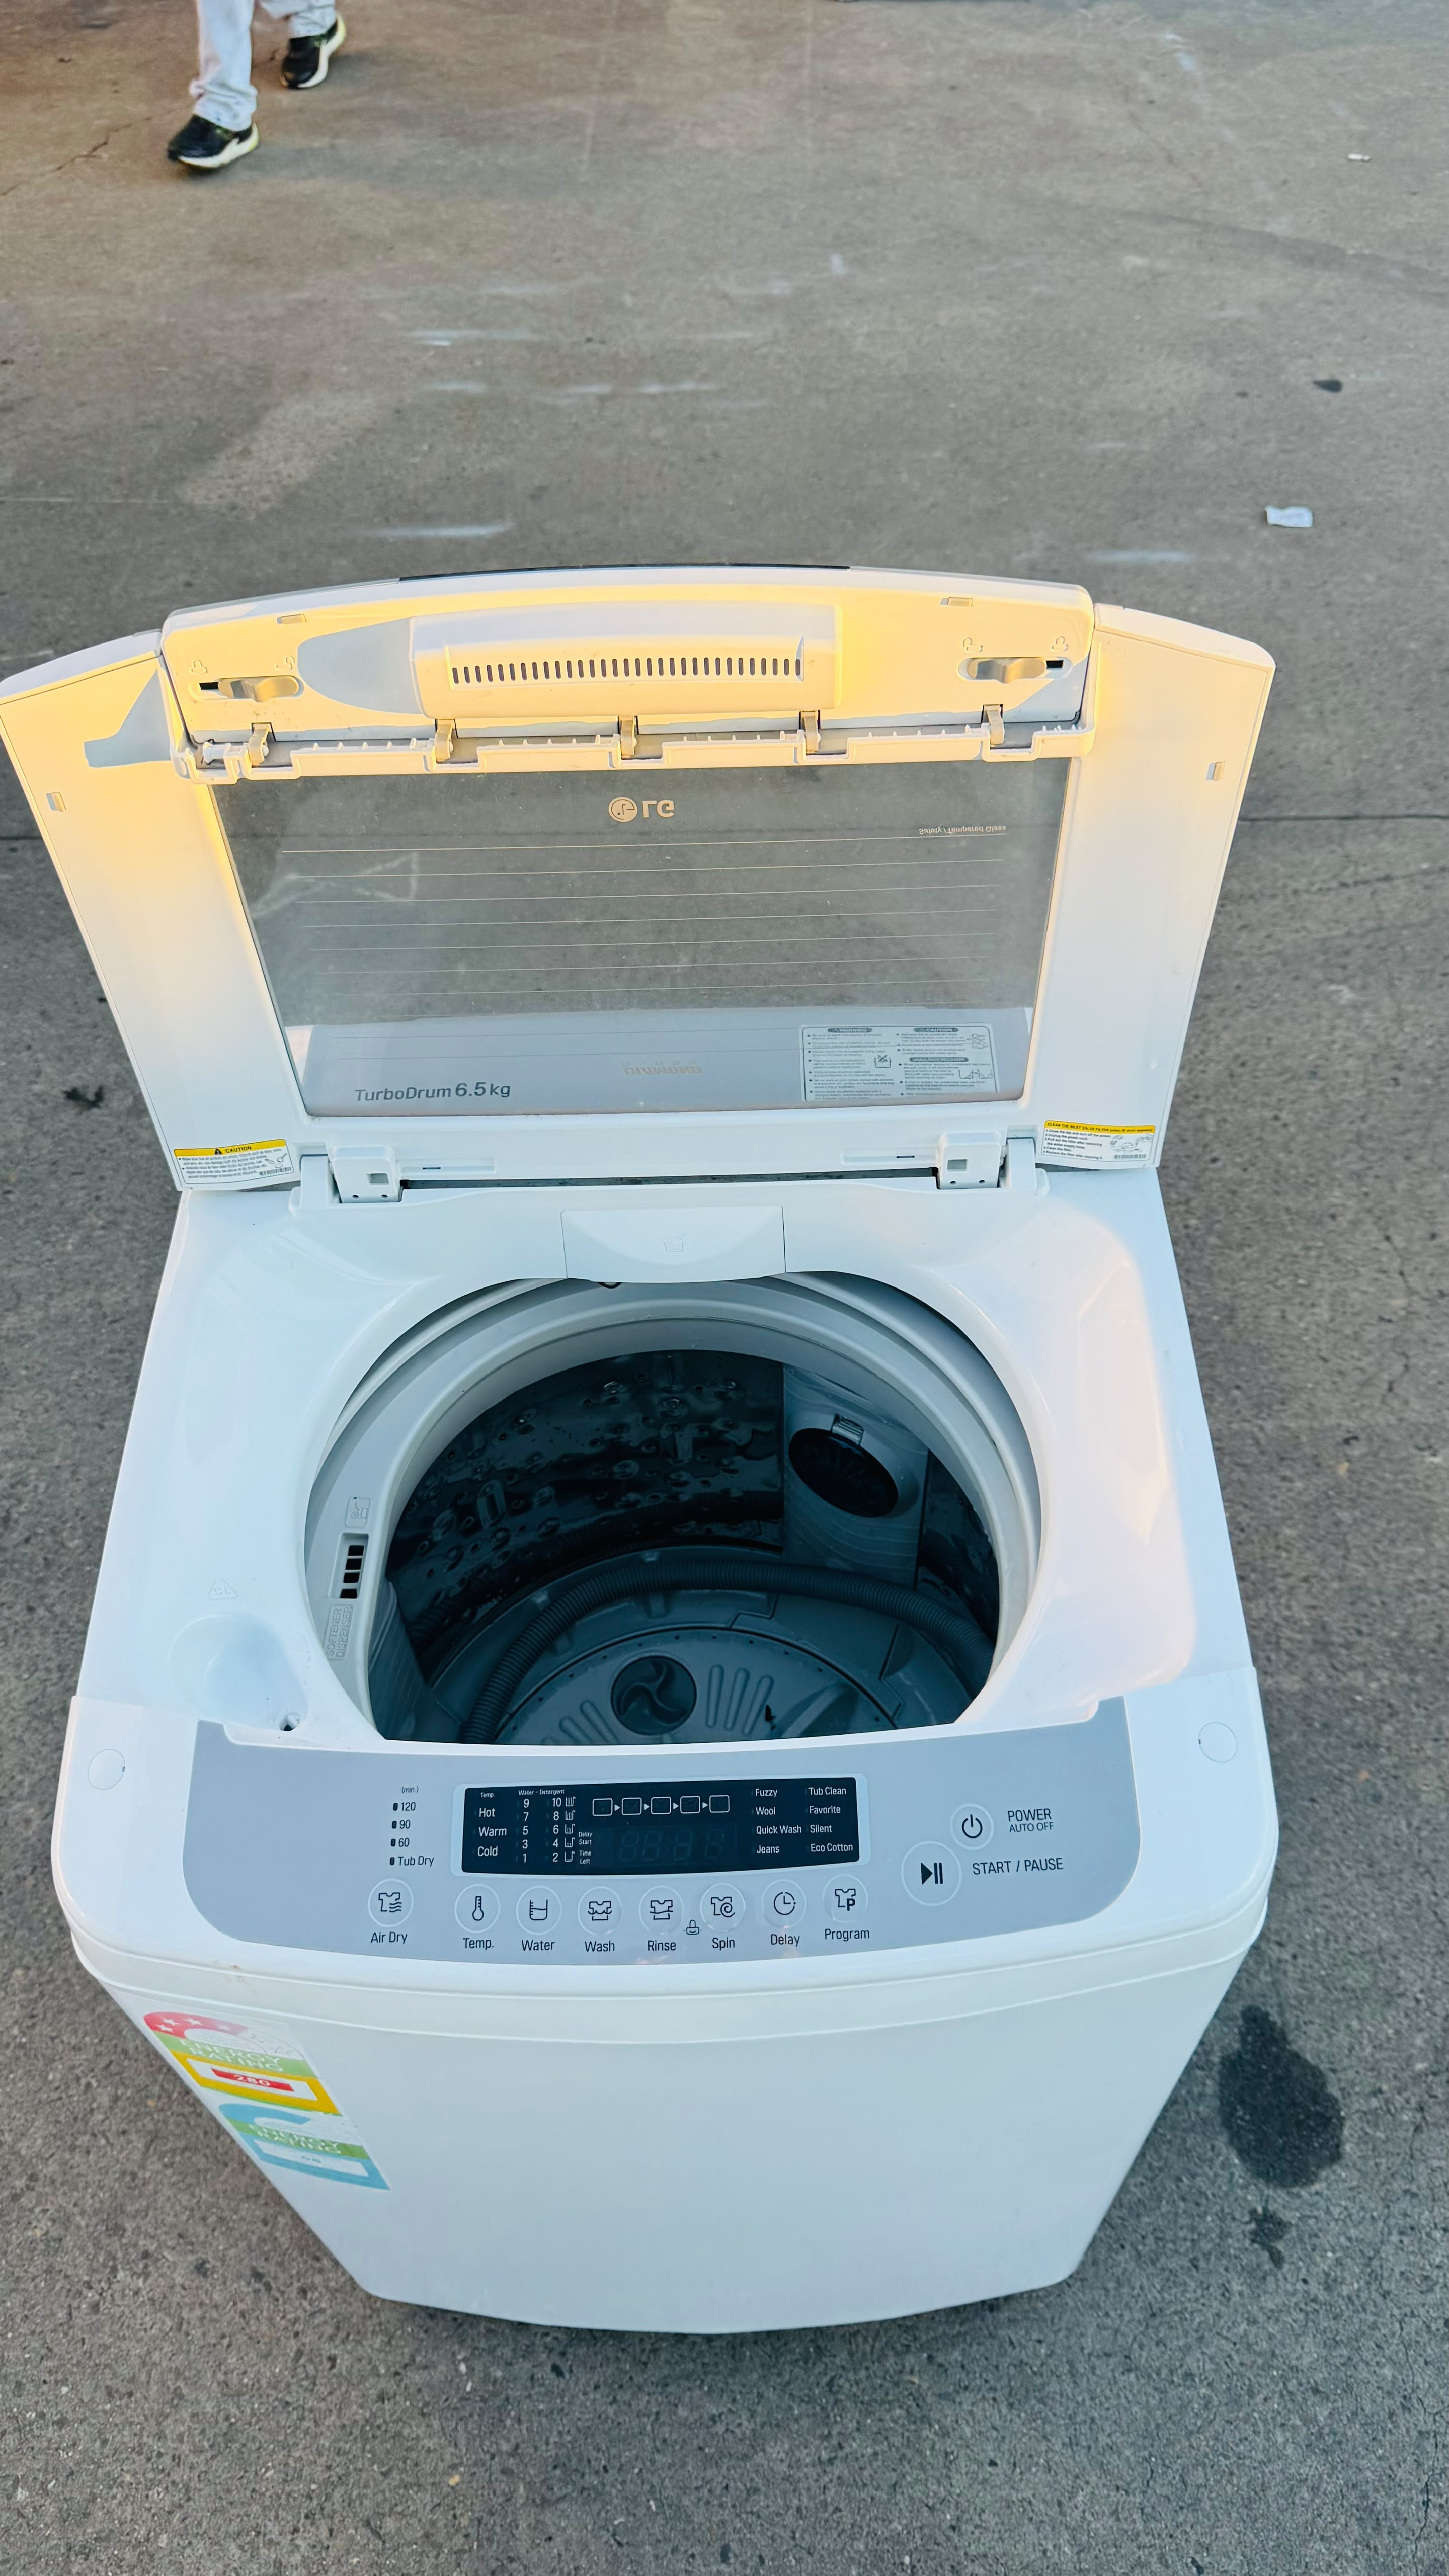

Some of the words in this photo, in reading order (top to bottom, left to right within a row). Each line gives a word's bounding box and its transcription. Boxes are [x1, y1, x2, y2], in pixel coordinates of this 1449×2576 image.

[355, 1087, 451, 1101] TurboDrum
[326, 1608, 342, 1656] SOFTENER
[336, 1607, 352, 1657] DISPENSER
[401, 1786, 419, 1794] (min.)
[755, 1789, 777, 1798] Fuzzy
[809, 1787, 823, 1795] Tub
[825, 1787, 846, 1795] Clean
[401, 1802, 416, 1811] 120
[524, 1799, 529, 1808] 9
[552, 1798, 561, 1807] 10
[479, 1808, 496, 1817] Hot
[756, 1807, 776, 1815] Wool
[810, 1805, 841, 1814] Favorite
[523, 1813, 529, 1821] 7
[553, 1811, 559, 1820] 8
[1007, 1808, 1052, 1822] POWER
[399, 1820, 411, 1829] 90
[810, 1824, 832, 1833] Silent
[1009, 1823, 1034, 1833] AUTO
[1036, 1822, 1054, 1831] OFF
[479, 1827, 507, 1836] Warm
[523, 1826, 528, 1835] 5
[553, 1825, 558, 1834] 6
[757, 1825, 778, 1834] Quick
[780, 1825, 802, 1833] Wash
[398, 1838, 410, 1847] 60
[522, 1840, 528, 1849] 3
[553, 1839, 558, 1848] 4
[477, 1846, 498, 1856] Cold
[757, 1844, 780, 1854] Jeans
[811, 1844, 825, 1853] Eco
[827, 1843, 853, 1852] Cotton
[398, 1857, 416, 1866] Tub
[418, 1856, 434, 1867] Dry
[522, 1854, 527, 1863] 1
[552, 1853, 558, 1862] 2
[973, 1861, 1011, 1875] START
[1016, 1861, 1020, 1872] /
[1024, 1858, 1064, 1872] PAUSE
[370, 1933, 386, 1943] Air
[389, 1932, 408, 1944] Dry
[825, 1929, 870, 1941] Program
[463, 1938, 494, 1949] Temp.
[522, 1940, 555, 1951] Water
[712, 1938, 735, 1949] Spin
[771, 1935, 800, 1947] Delay
[585, 1942, 615, 1952] Wash
[648, 1941, 676, 1951] Rinse
[179, 2039, 280, 2063] ENERGY
[189, 2048, 283, 2071] RATING
